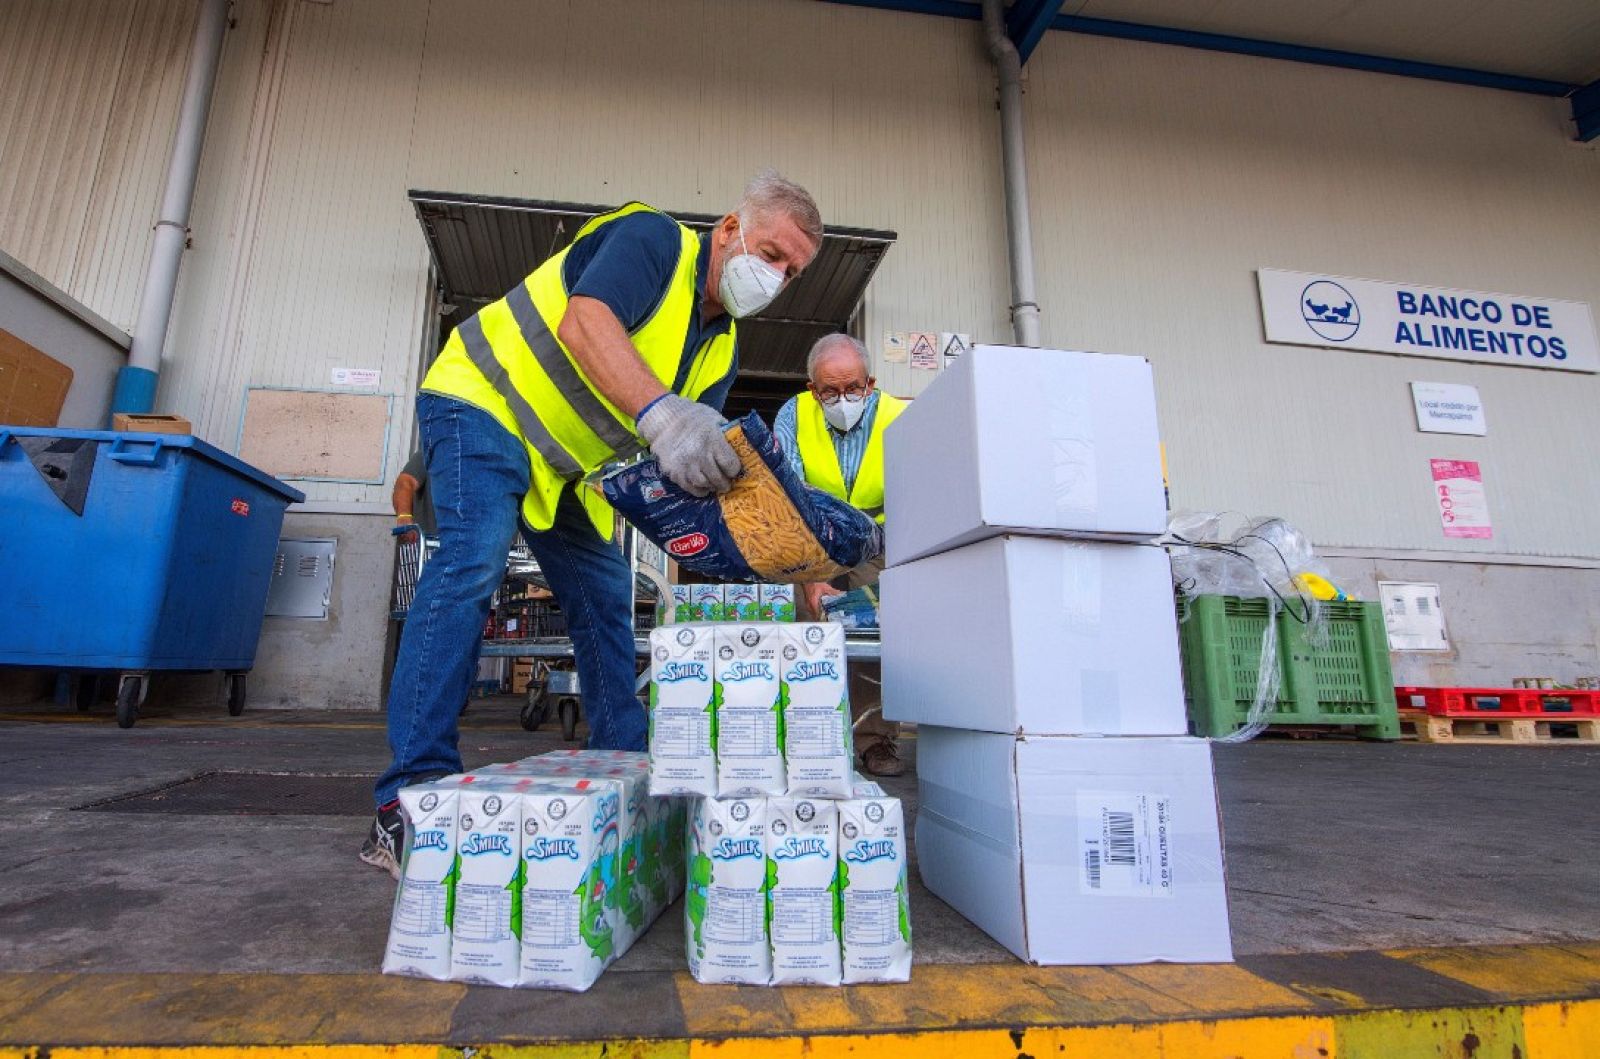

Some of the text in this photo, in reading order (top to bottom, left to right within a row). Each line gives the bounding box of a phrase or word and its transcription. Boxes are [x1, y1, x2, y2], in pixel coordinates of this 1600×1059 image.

[1396, 290, 1554, 329] BANCO DE
[1395, 321, 1568, 360] ALIMENTOS
